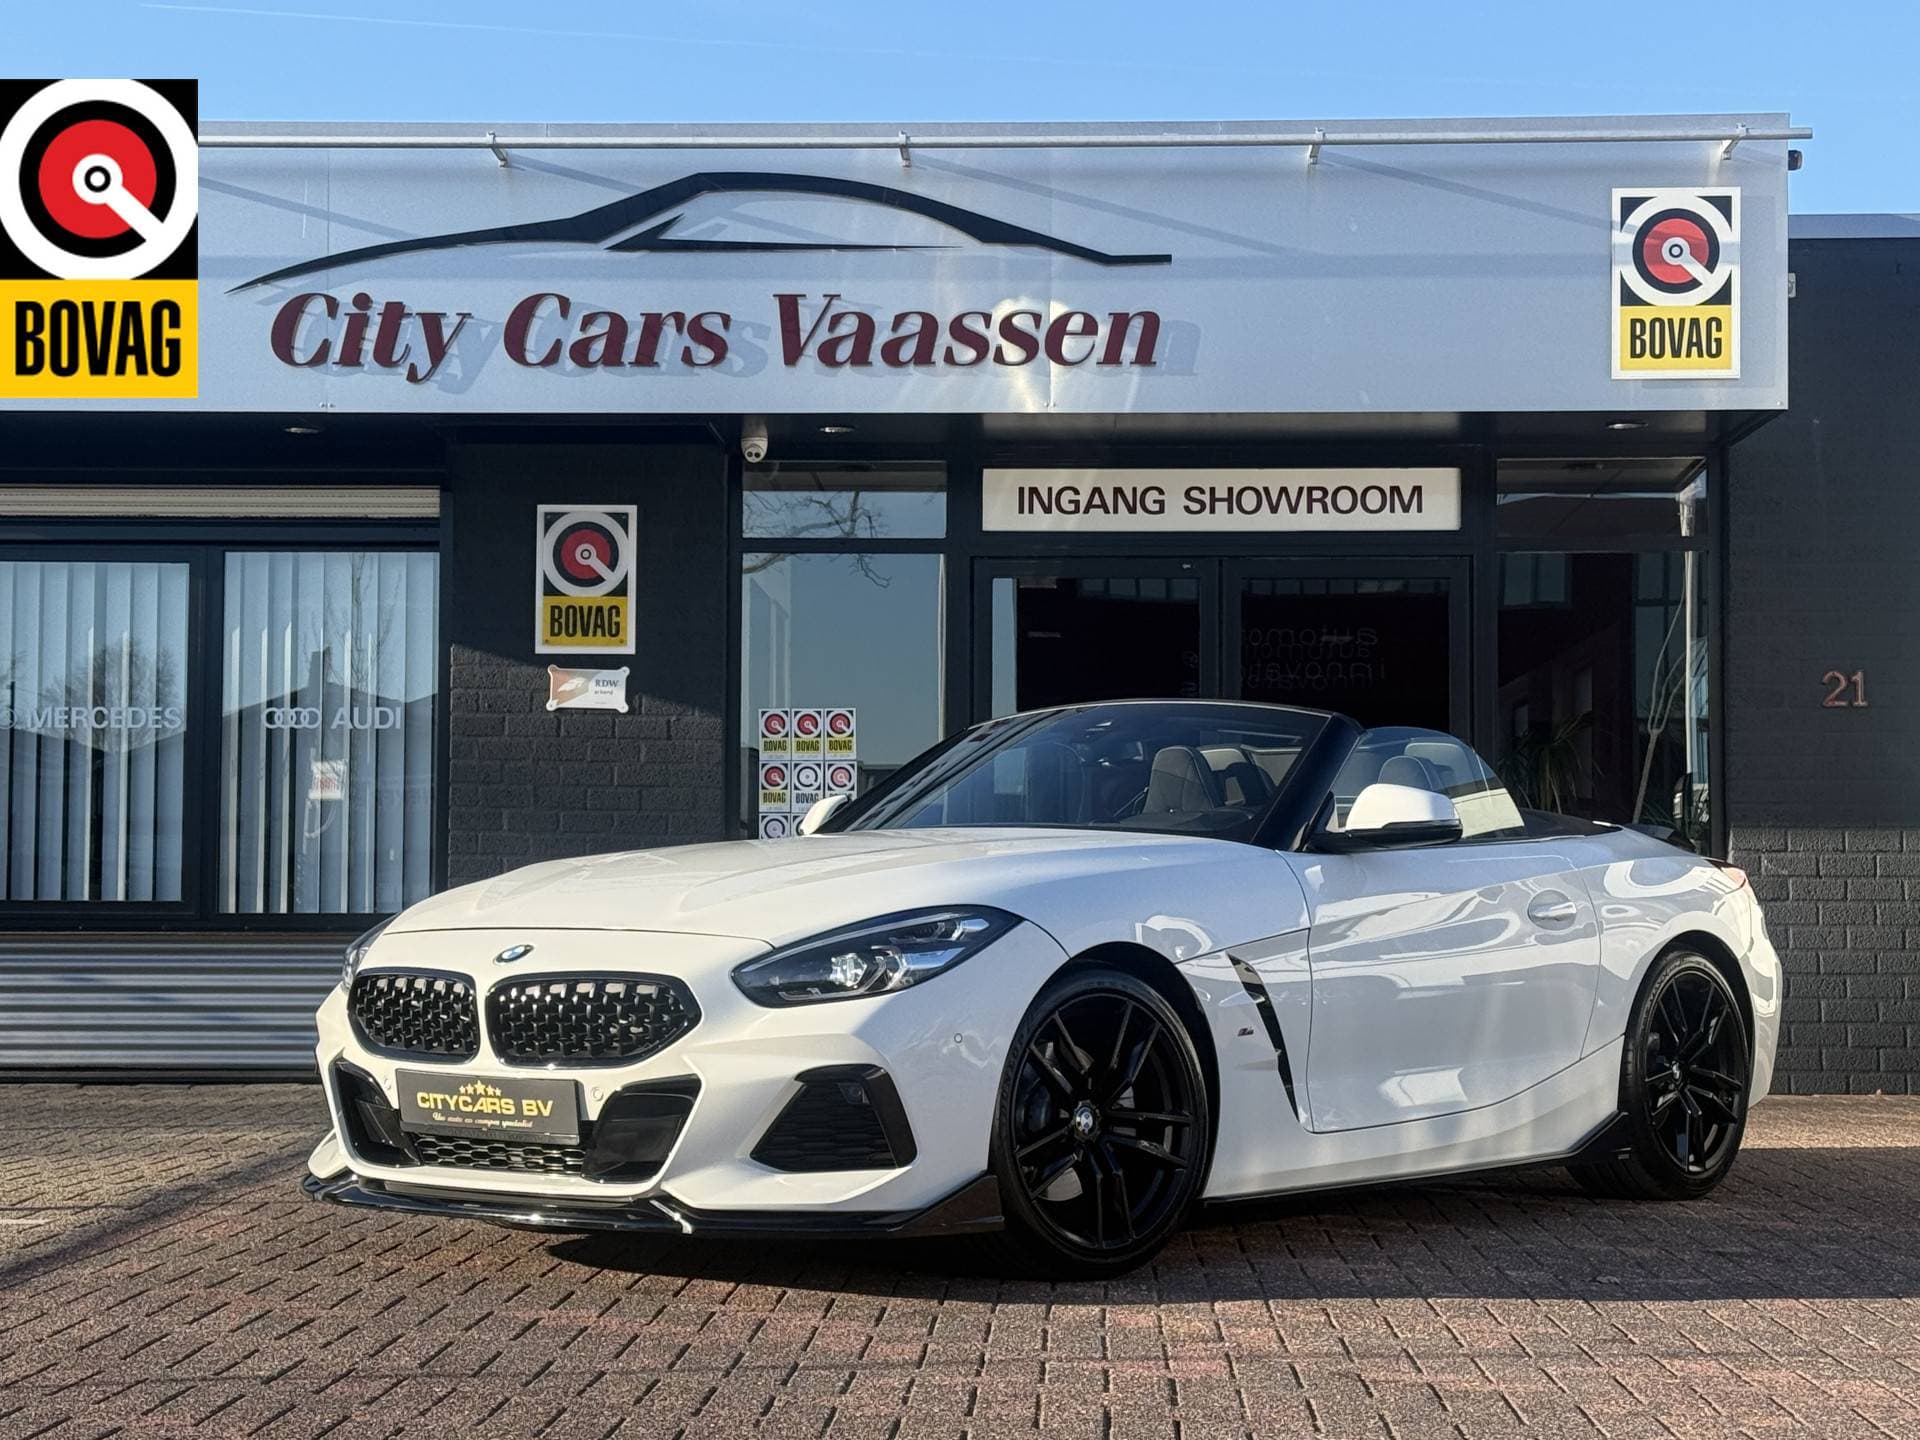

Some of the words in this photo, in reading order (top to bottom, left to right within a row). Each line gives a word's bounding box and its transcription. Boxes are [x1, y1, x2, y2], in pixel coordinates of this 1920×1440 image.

[270, 292, 471, 383] City
[504, 292, 731, 367] Cars
[774, 293, 1162, 367] Vaassen
[1629, 316, 1723, 360] BOVAG
[1017, 485, 1166, 515] INGANG
[1182, 484, 1424, 515] SHOWROOM
[549, 604, 621, 638] BOVAG
[595, 679, 619, 688] RDW
[1821, 670, 1869, 708] 21
[27, 706, 182, 729] MERCEDES
[331, 706, 401, 730] AUDI
[763, 740, 787, 751] BOVAG
[796, 740, 819, 751] BOVAG
[828, 739, 852, 751] BOVAG
[763, 792, 786, 804] BOVAG
[416, 1092, 515, 1115] CITYCARS
[522, 1099, 554, 1117] BV
